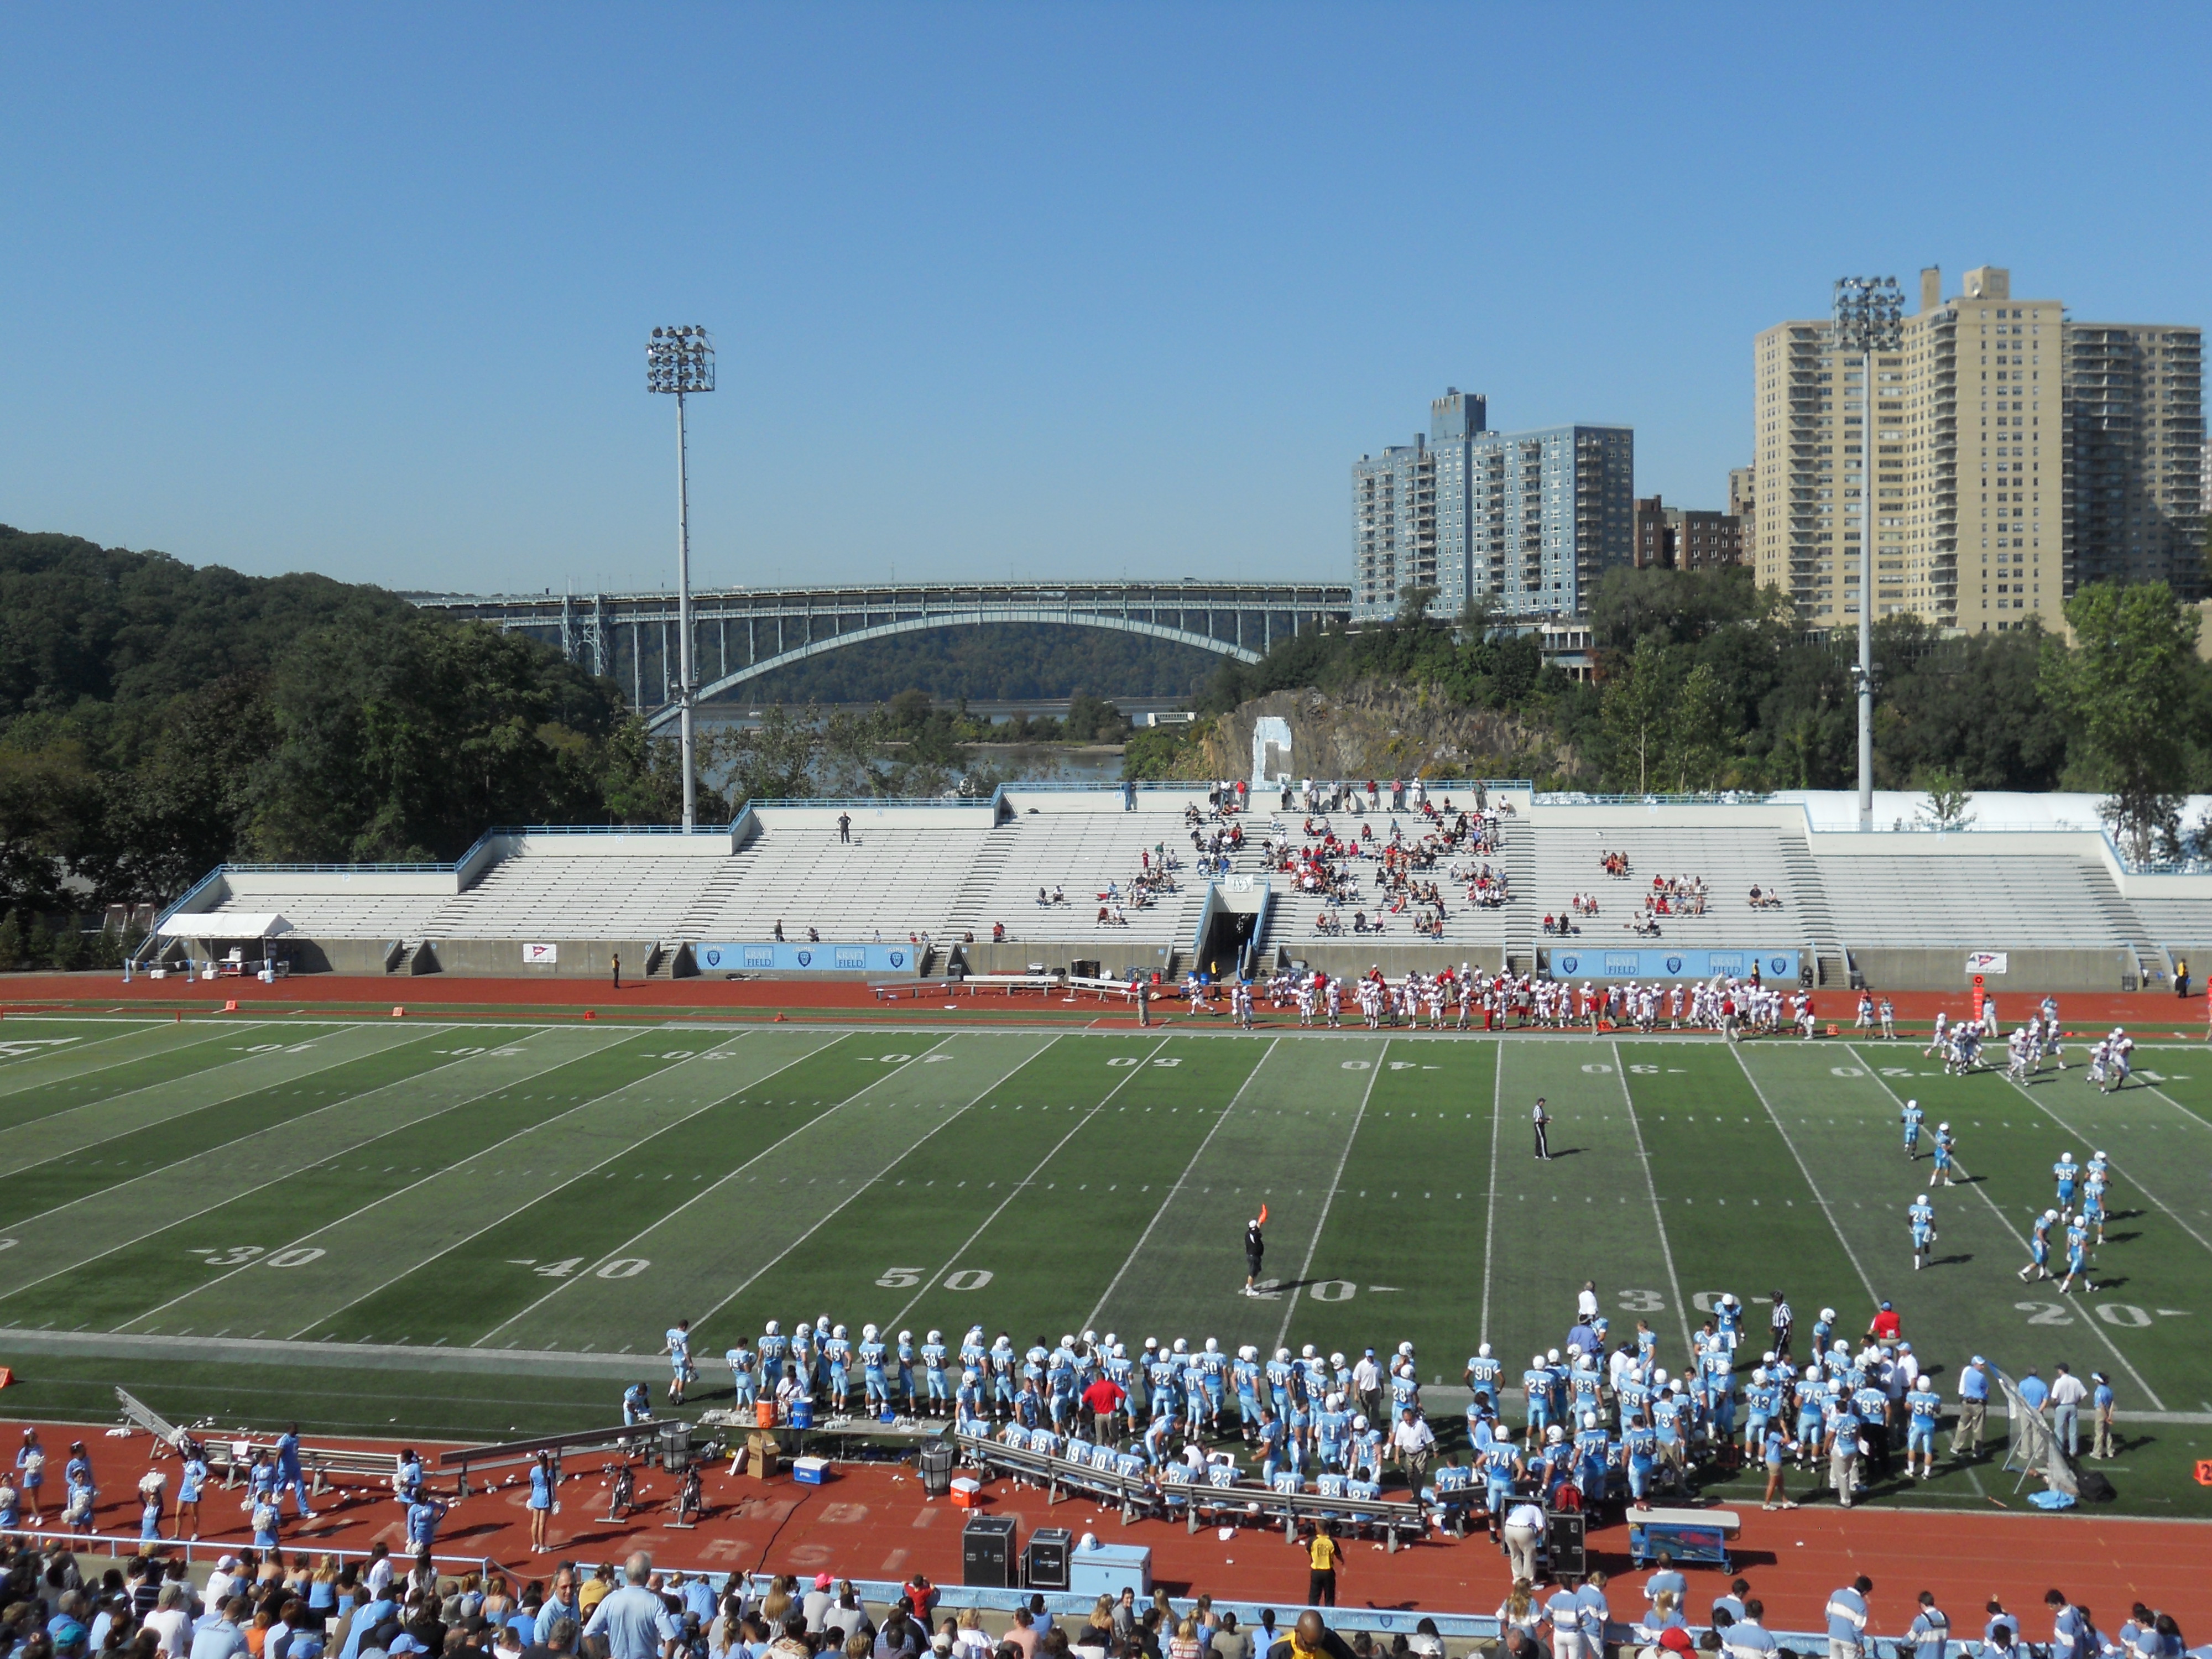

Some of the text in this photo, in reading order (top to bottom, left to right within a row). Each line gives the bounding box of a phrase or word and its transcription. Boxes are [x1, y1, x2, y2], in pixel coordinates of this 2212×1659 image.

[1252, 717, 1292, 790] C
[744, 951, 773, 959] KRAFT
[836, 951, 864, 960] KRAFT
[1605, 957, 1637, 967] KRAFT
[1710, 957, 1742, 967] KRAFT
[747, 958, 771, 967] FIELD
[838, 959, 863, 968] FIELD
[1608, 966, 1635, 975] FIELD
[1713, 966, 1740, 975] FIELD
[450, 1047, 529, 1056] 20
[661, 1050, 736, 1060] 30
[880, 1053, 954, 1064] 40
[1105, 1057, 1182, 1068] 50
[1341, 1060, 1417, 1071] 40
[1580, 1063, 1658, 1074] 30
[1830, 1066, 1914, 1078] 20
[1907, 1114, 1917, 1123] 14
[2058, 1168, 2073, 1181] 95
[1912, 1210, 1927, 1223] 24
[204, 1246, 326, 1267] 30
[533, 1257, 651, 1279] 40
[875, 1267, 994, 1291] 50
[1618, 1290, 1742, 1313] 30
[1724, 1315, 1731, 1326] 5
[2014, 1301, 2153, 1327] 20
[764, 1344, 782, 1358] 96
[862, 1352, 879, 1366] 92
[923, 1353, 938, 1367] 58
[1154, 1370, 1170, 1386] 22
[1474, 1365, 1492, 1381] 90
[1528, 1378, 1546, 1395] 25
[1575, 1379, 1593, 1394] 83
[1392, 1385, 1407, 1403] 28
[1622, 1390, 1640, 1408] 69
[1804, 1389, 1822, 1406] 79
[1752, 1395, 1770, 1409] 43
[1861, 1399, 1881, 1415] 93
[1653, 1411, 1670, 1429] 73
[1328, 1424, 1334, 1440] 1
[1030, 1434, 1047, 1453] 86
[1588, 1438, 1606, 1457] 77
[1635, 1438, 1652, 1454] 75
[1091, 1452, 1106, 1470] 10
[1490, 1451, 1510, 1469] 74
[1213, 1470, 1232, 1488] 23
[1276, 1479, 1296, 1494] 20
[1322, 1480, 1341, 1497] 84
[1401, 1619, 1494, 1630] STUNT SECTION
